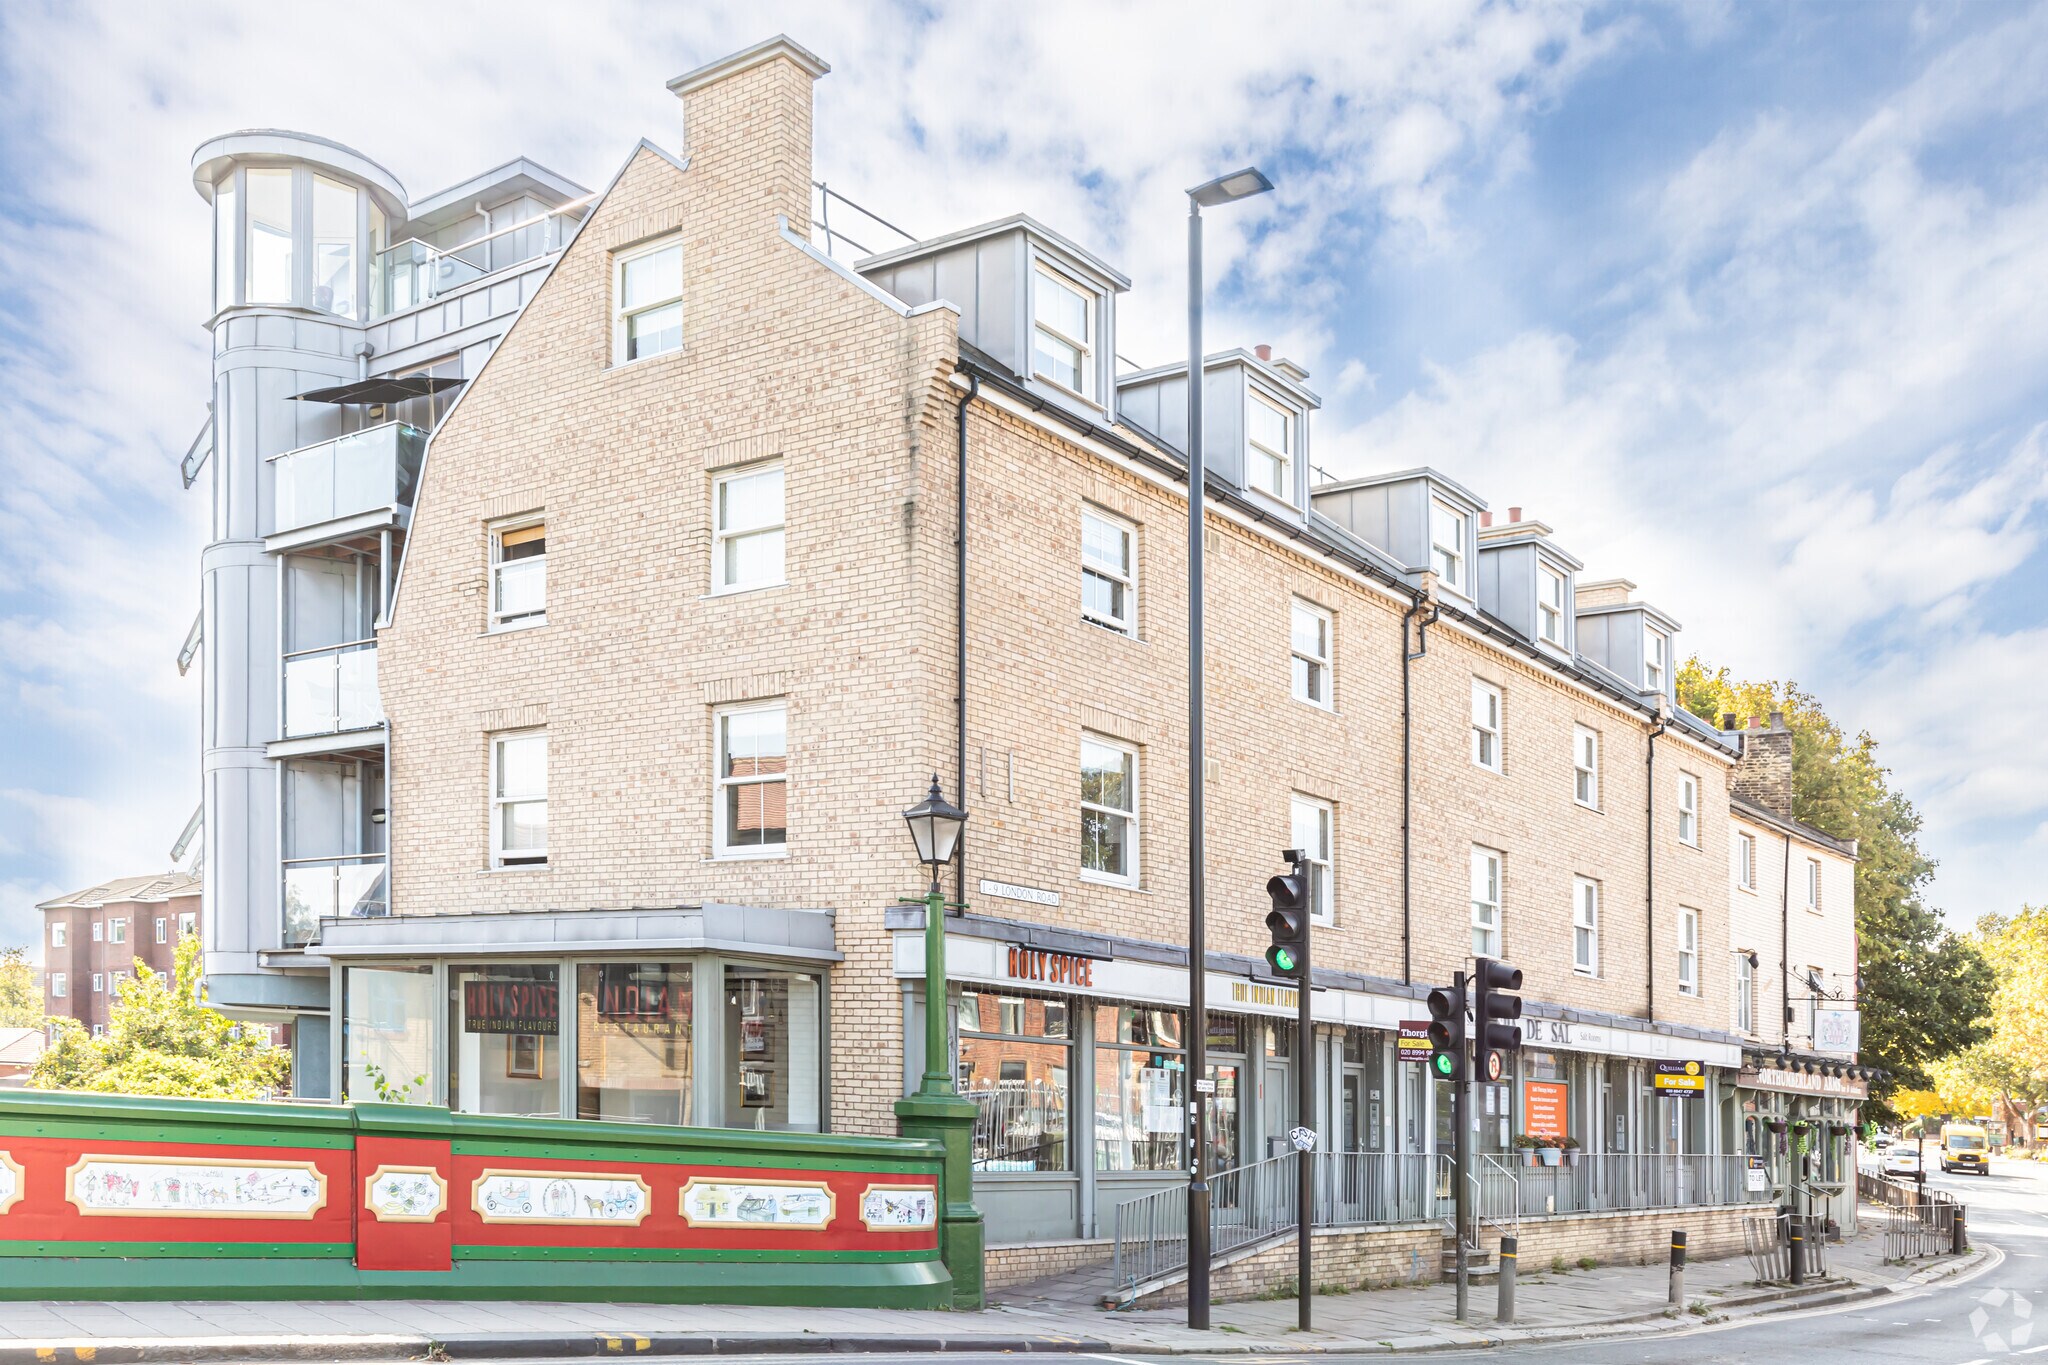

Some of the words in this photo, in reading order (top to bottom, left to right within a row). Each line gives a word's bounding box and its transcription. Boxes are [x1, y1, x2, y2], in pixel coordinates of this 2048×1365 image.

[993, 884, 998, 894] 9
[1001, 886, 1033, 900] LONDON
[1037, 891, 1057, 904] ROAD
[1009, 947, 1047, 981] HOLY
[1051, 953, 1093, 987] SPICE
[468, 984, 506, 1017] HOLY
[510, 984, 557, 1018] SPICE
[1232, 982, 1248, 1002] TRUE
[1252, 985, 1275, 1006] INDIAN
[468, 1019, 486, 1030] TRUE
[489, 1019, 515, 1031] INDIAN
[518, 1020, 557, 1032] FLAVOURS
[593, 1022, 692, 1035] RESTAURANT
[1400, 1029, 1428, 1038] Thorgi
[1526, 1019, 1543, 1041] DE
[1551, 1022, 1573, 1044] SAL
[1678, 1078, 1696, 1086] Sale
[1757, 1068, 1821, 1090] NORTHUMBERLAND
